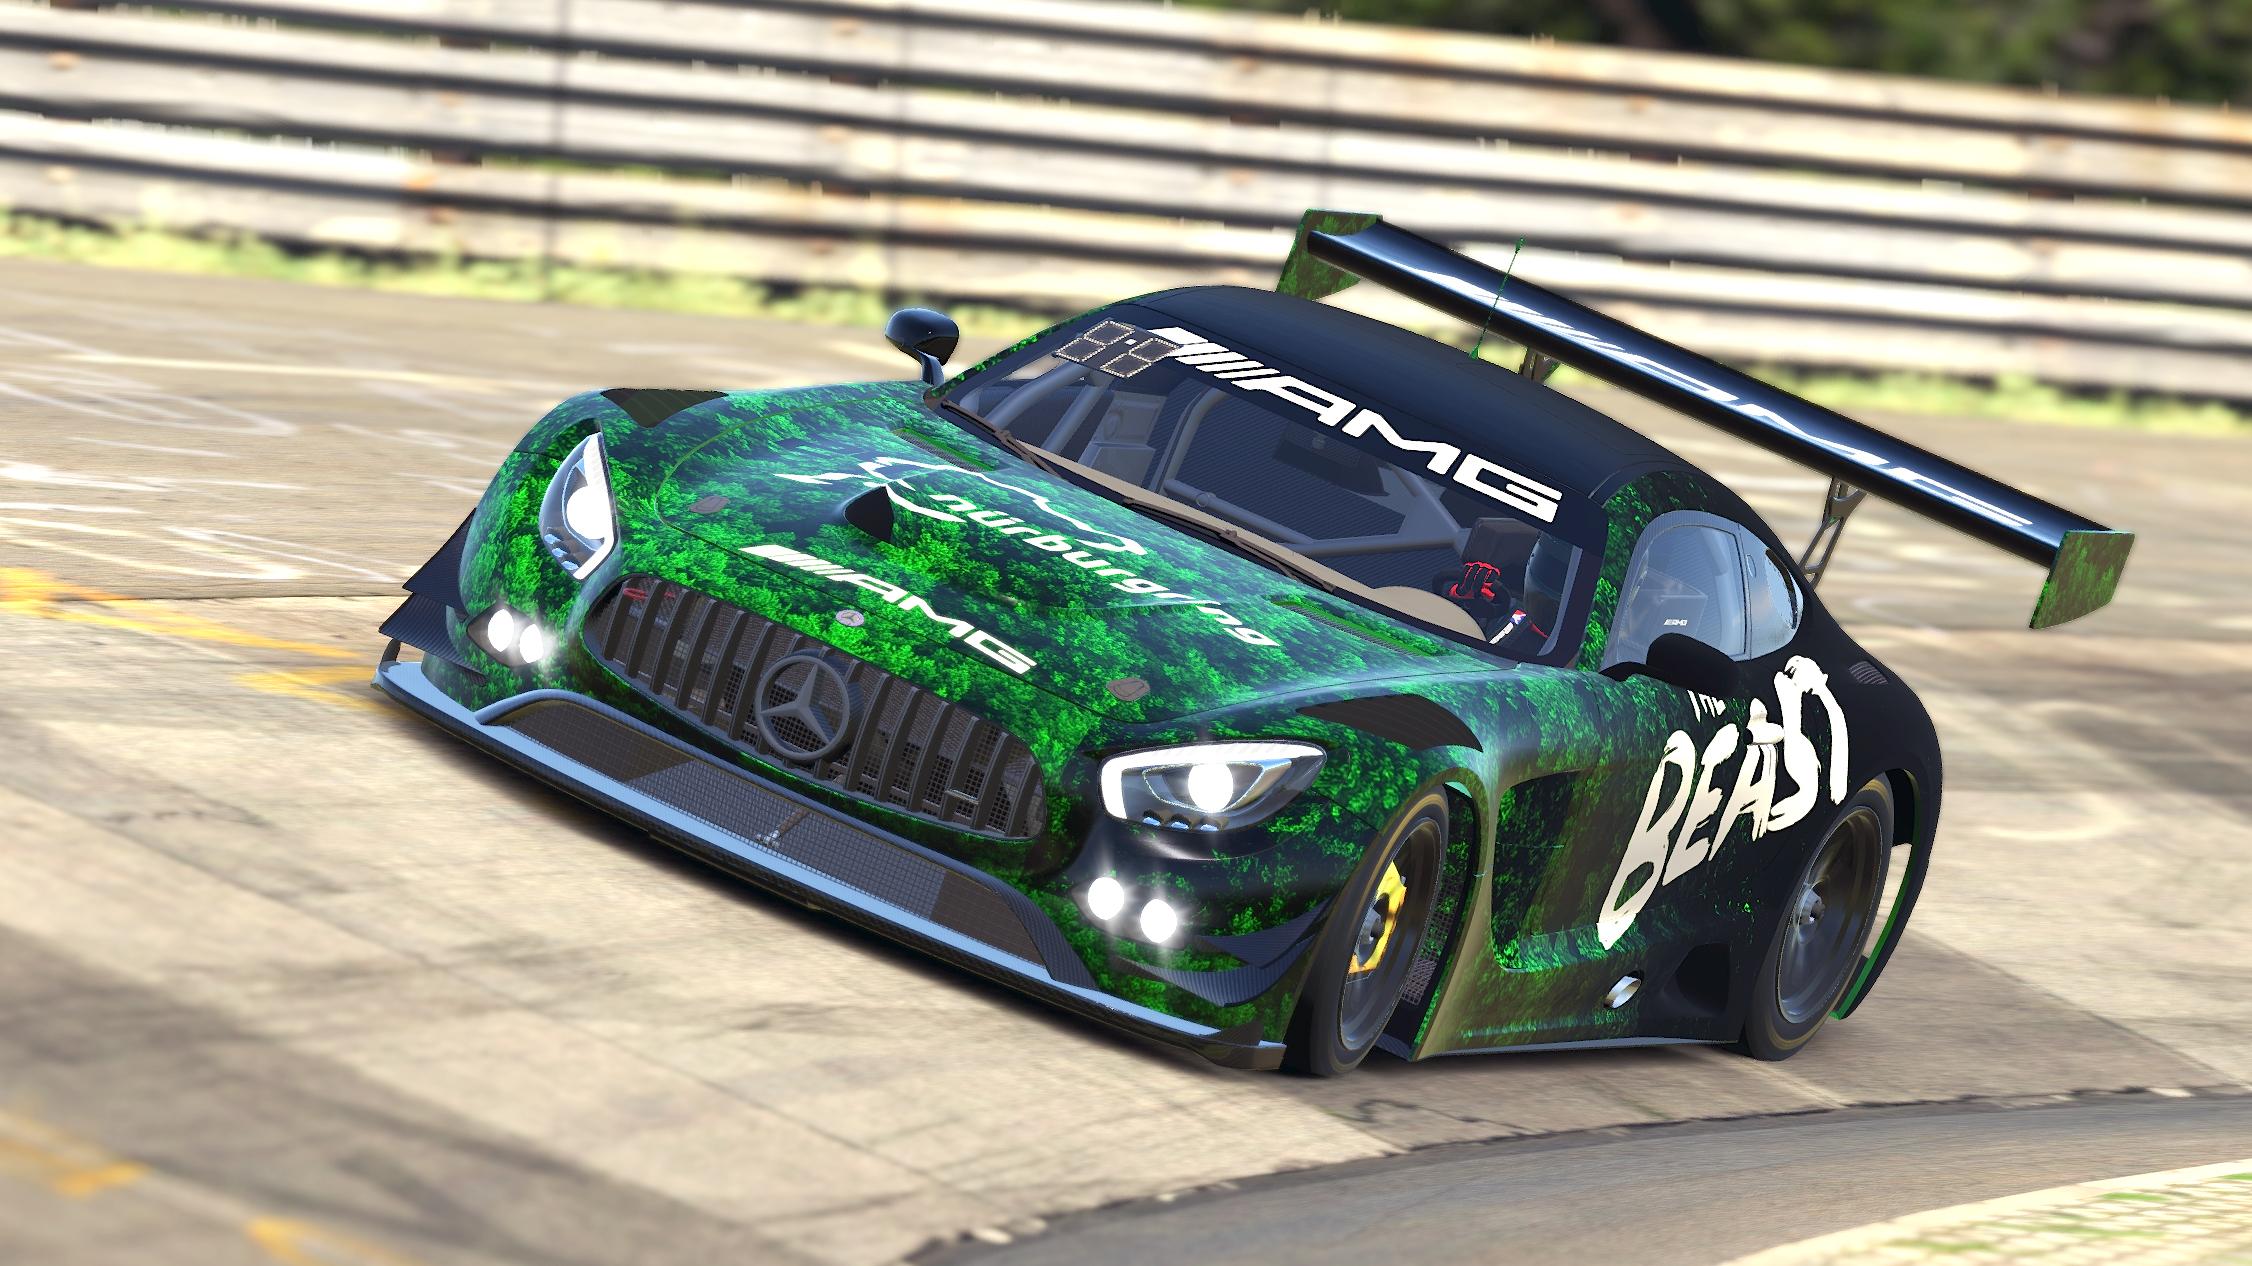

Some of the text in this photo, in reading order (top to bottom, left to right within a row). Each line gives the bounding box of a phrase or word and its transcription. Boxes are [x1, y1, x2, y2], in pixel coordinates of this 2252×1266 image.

[1231, 375, 1562, 523] AMG
[825, 573, 1038, 675] AMG
[1595, 655, 1849, 950] BEAST
